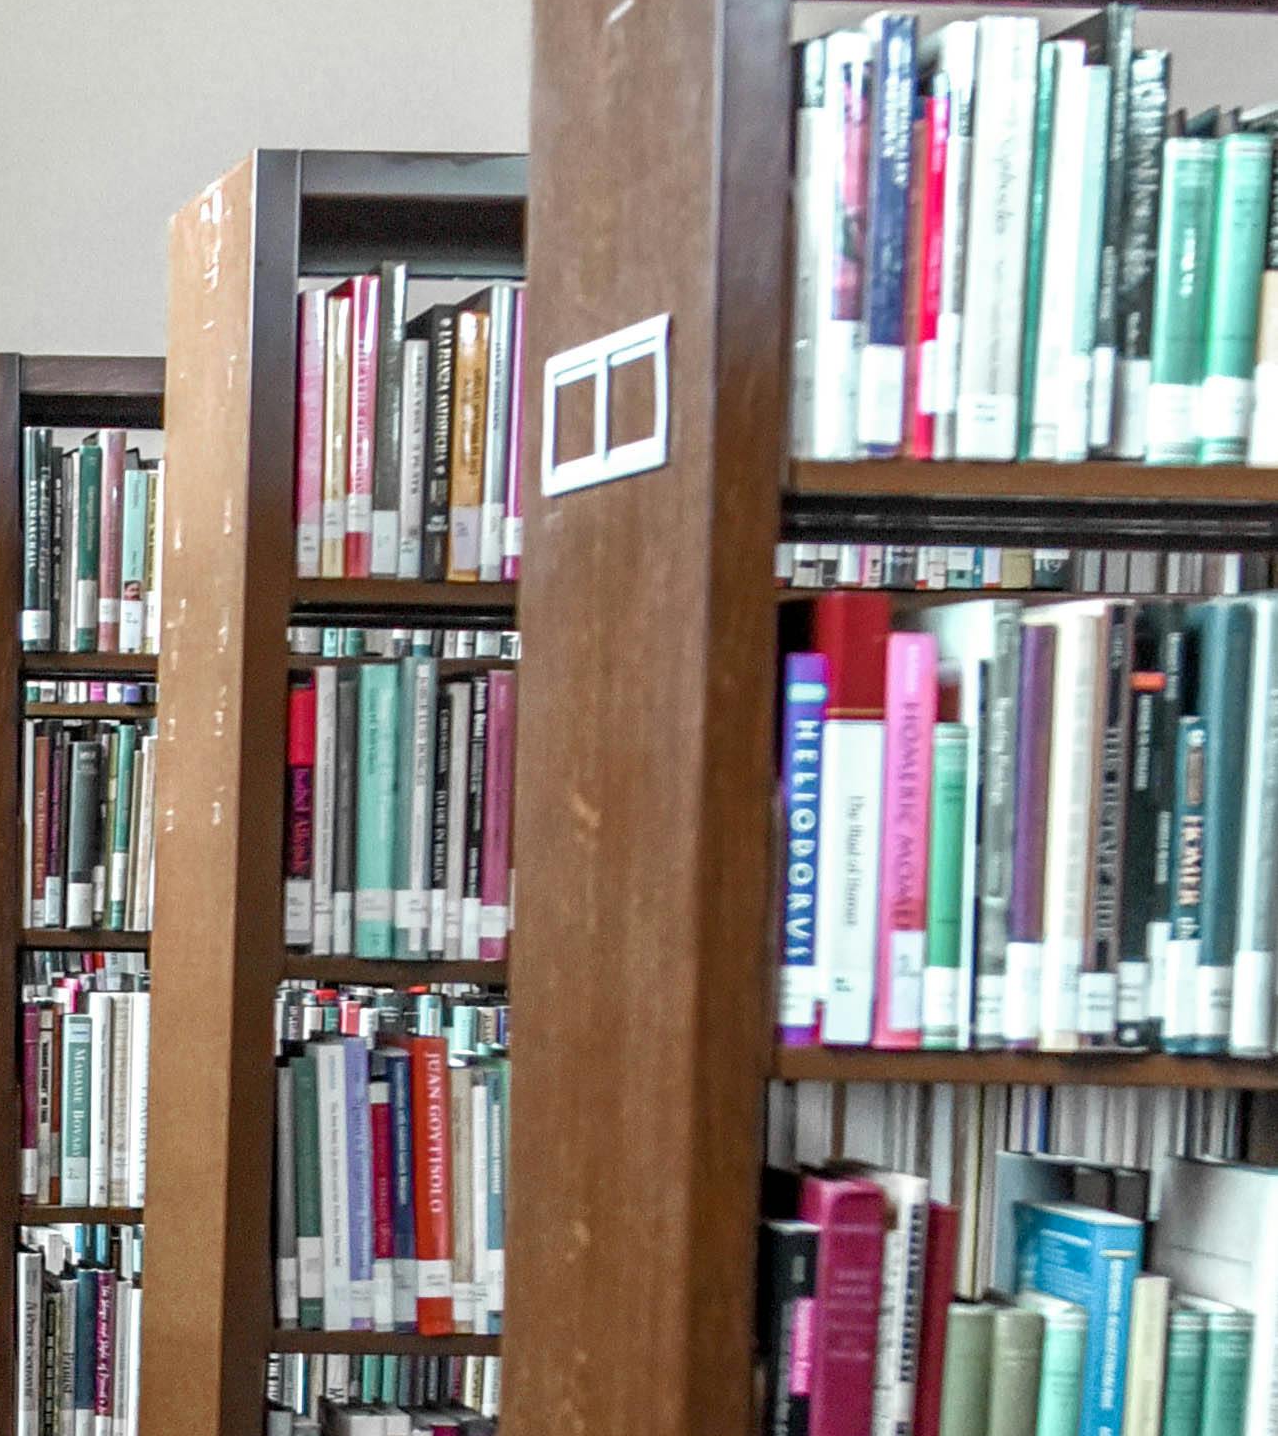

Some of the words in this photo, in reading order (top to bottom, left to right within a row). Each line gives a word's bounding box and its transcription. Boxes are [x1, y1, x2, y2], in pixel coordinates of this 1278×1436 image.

[894, 701, 922, 826] HOMERIC
[785, 719, 820, 957] HELIODORVS
[1177, 815, 1204, 908] HOMER
[73, 1049, 86, 1103] MADAME
[426, 1052, 443, 1099] JUAN
[427, 1105, 445, 1214] GOYTISOLO
